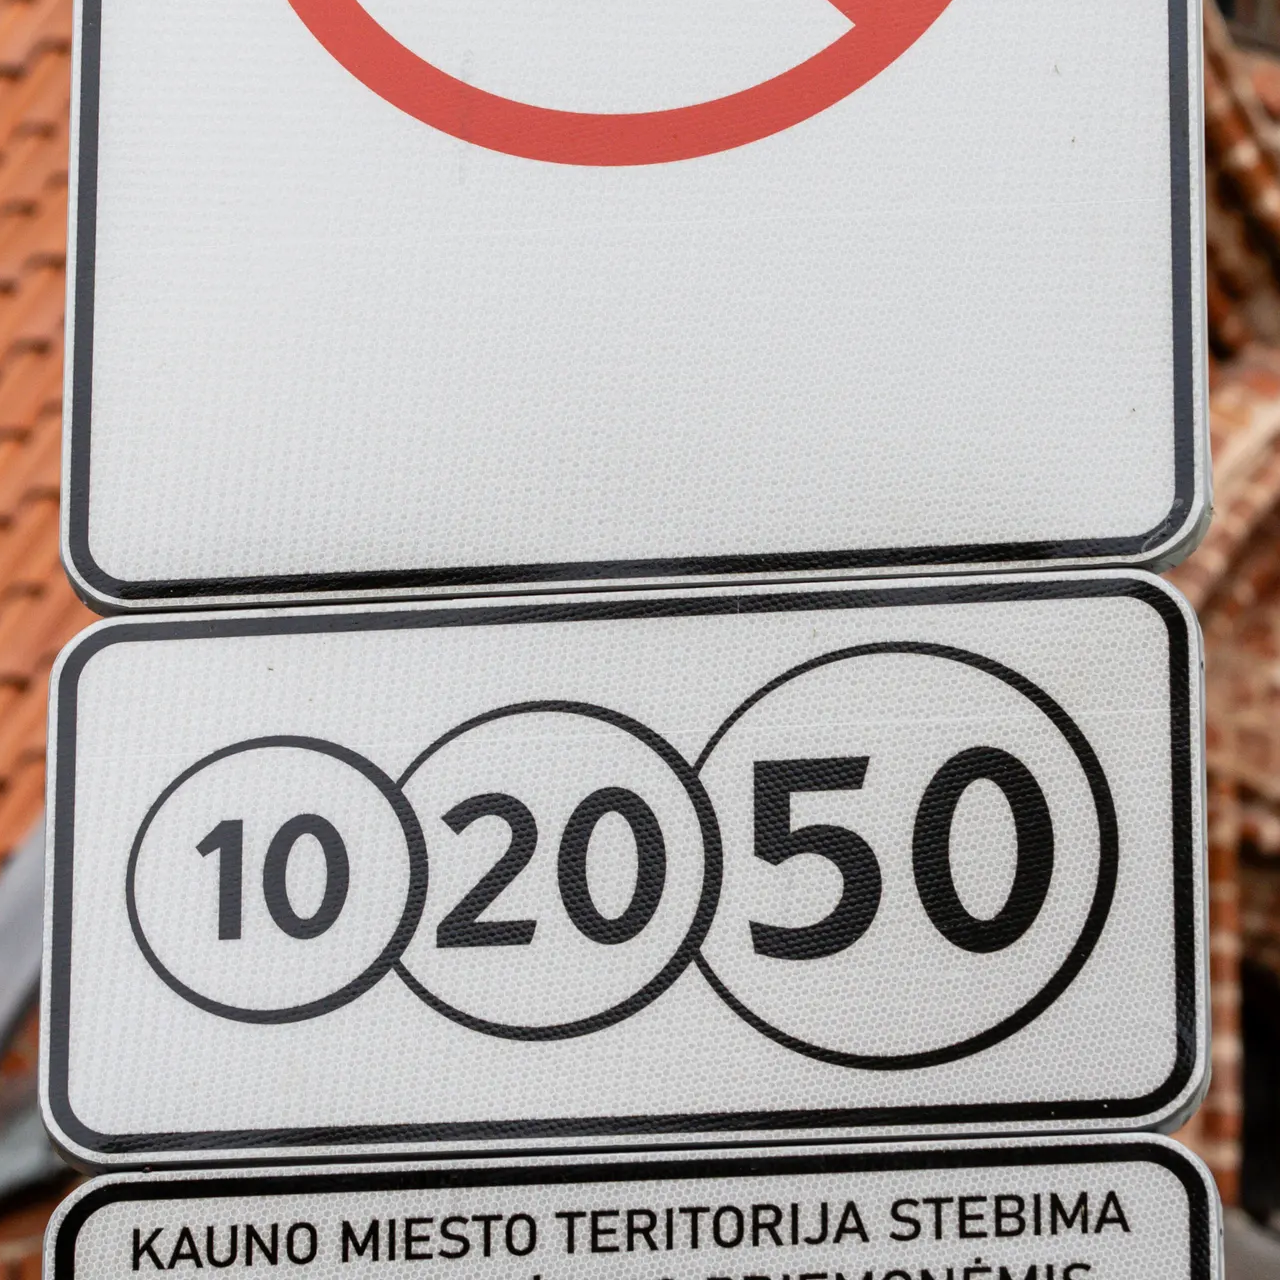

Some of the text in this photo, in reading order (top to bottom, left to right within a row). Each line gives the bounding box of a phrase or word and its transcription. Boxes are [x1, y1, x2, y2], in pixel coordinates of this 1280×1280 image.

[195, 745, 1055, 962] 10 20 50
[131, 1190, 1131, 1271] KAUNO MIESTO TERITORIJA STEBIMA
